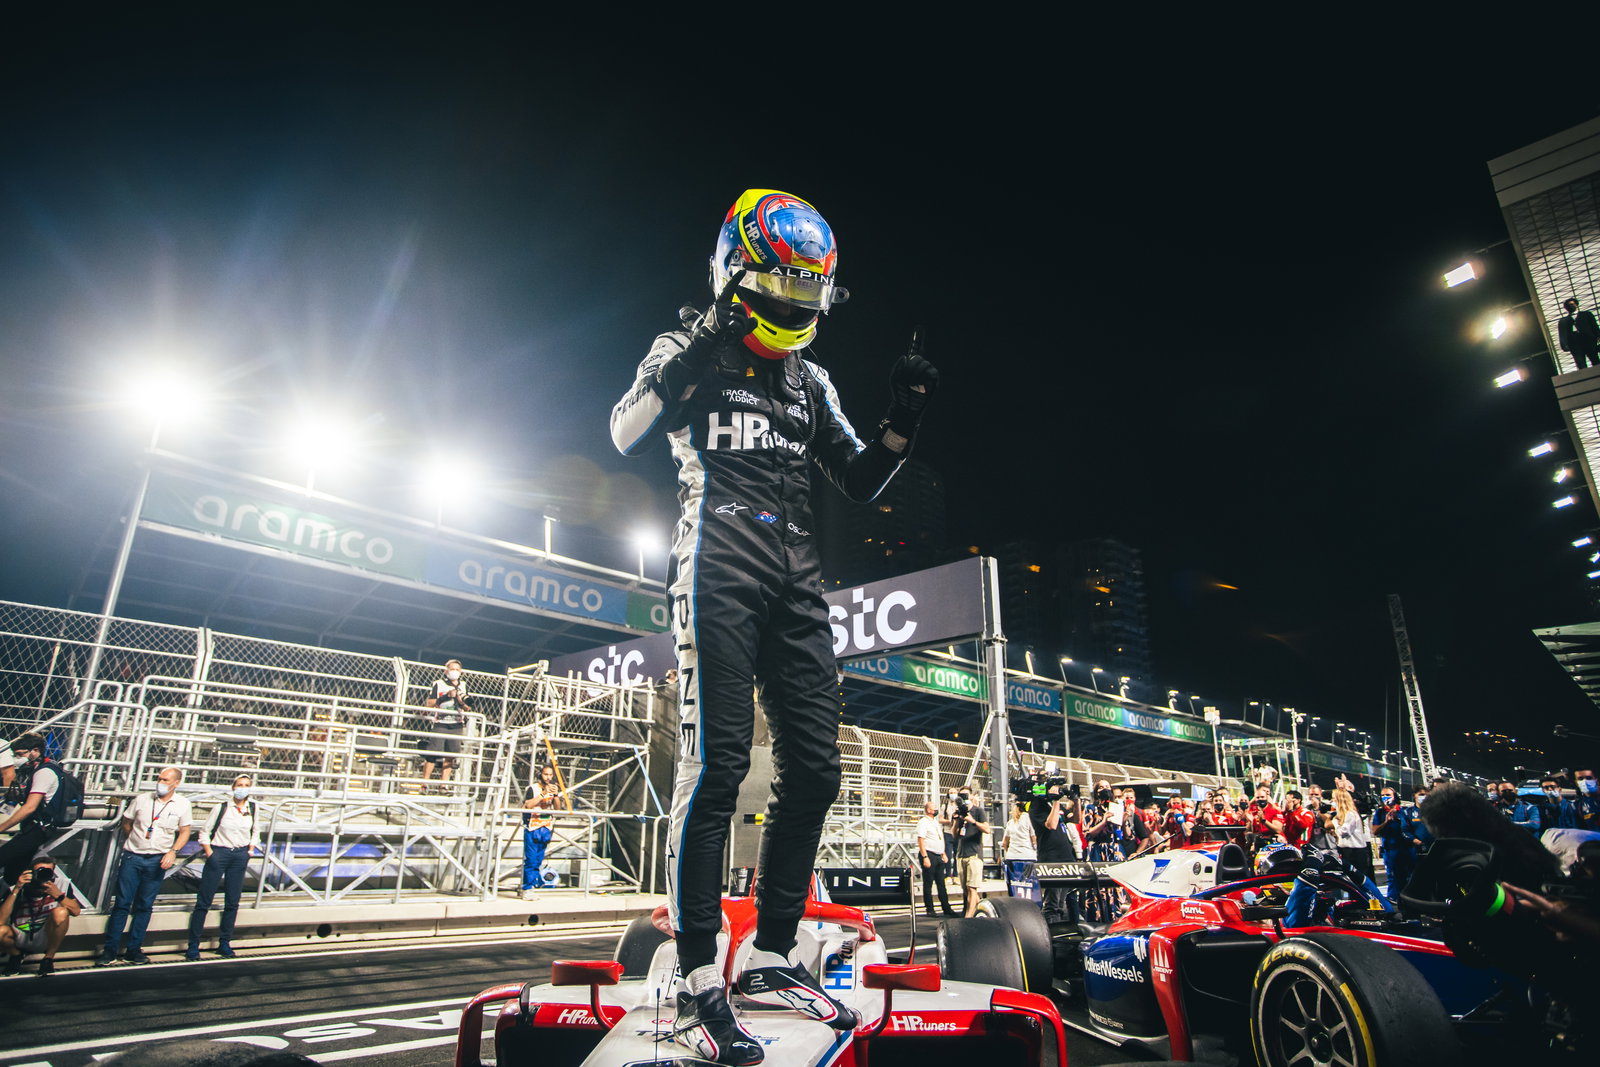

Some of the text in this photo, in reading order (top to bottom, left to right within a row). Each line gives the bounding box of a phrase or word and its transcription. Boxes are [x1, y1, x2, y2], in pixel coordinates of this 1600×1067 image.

[769, 266, 835, 288] ALPINE
[192, 496, 395, 566] aramco
[457, 559, 604, 613] aramco
[829, 588, 918, 657] stc
[587, 645, 645, 697] stc
[915, 665, 979, 693] aramco
[1005, 684, 1051, 707] ramco
[1075, 698, 1117, 721] aramco
[1128, 713, 1165, 732] aramco
[1175, 722, 1206, 739] aramco
[1084, 955, 1145, 983] VolkerWessels
[1262, 946, 1311, 972] ZERO
[750, 973, 763, 986] 2
[891, 1015, 957, 1031] HPtuners
